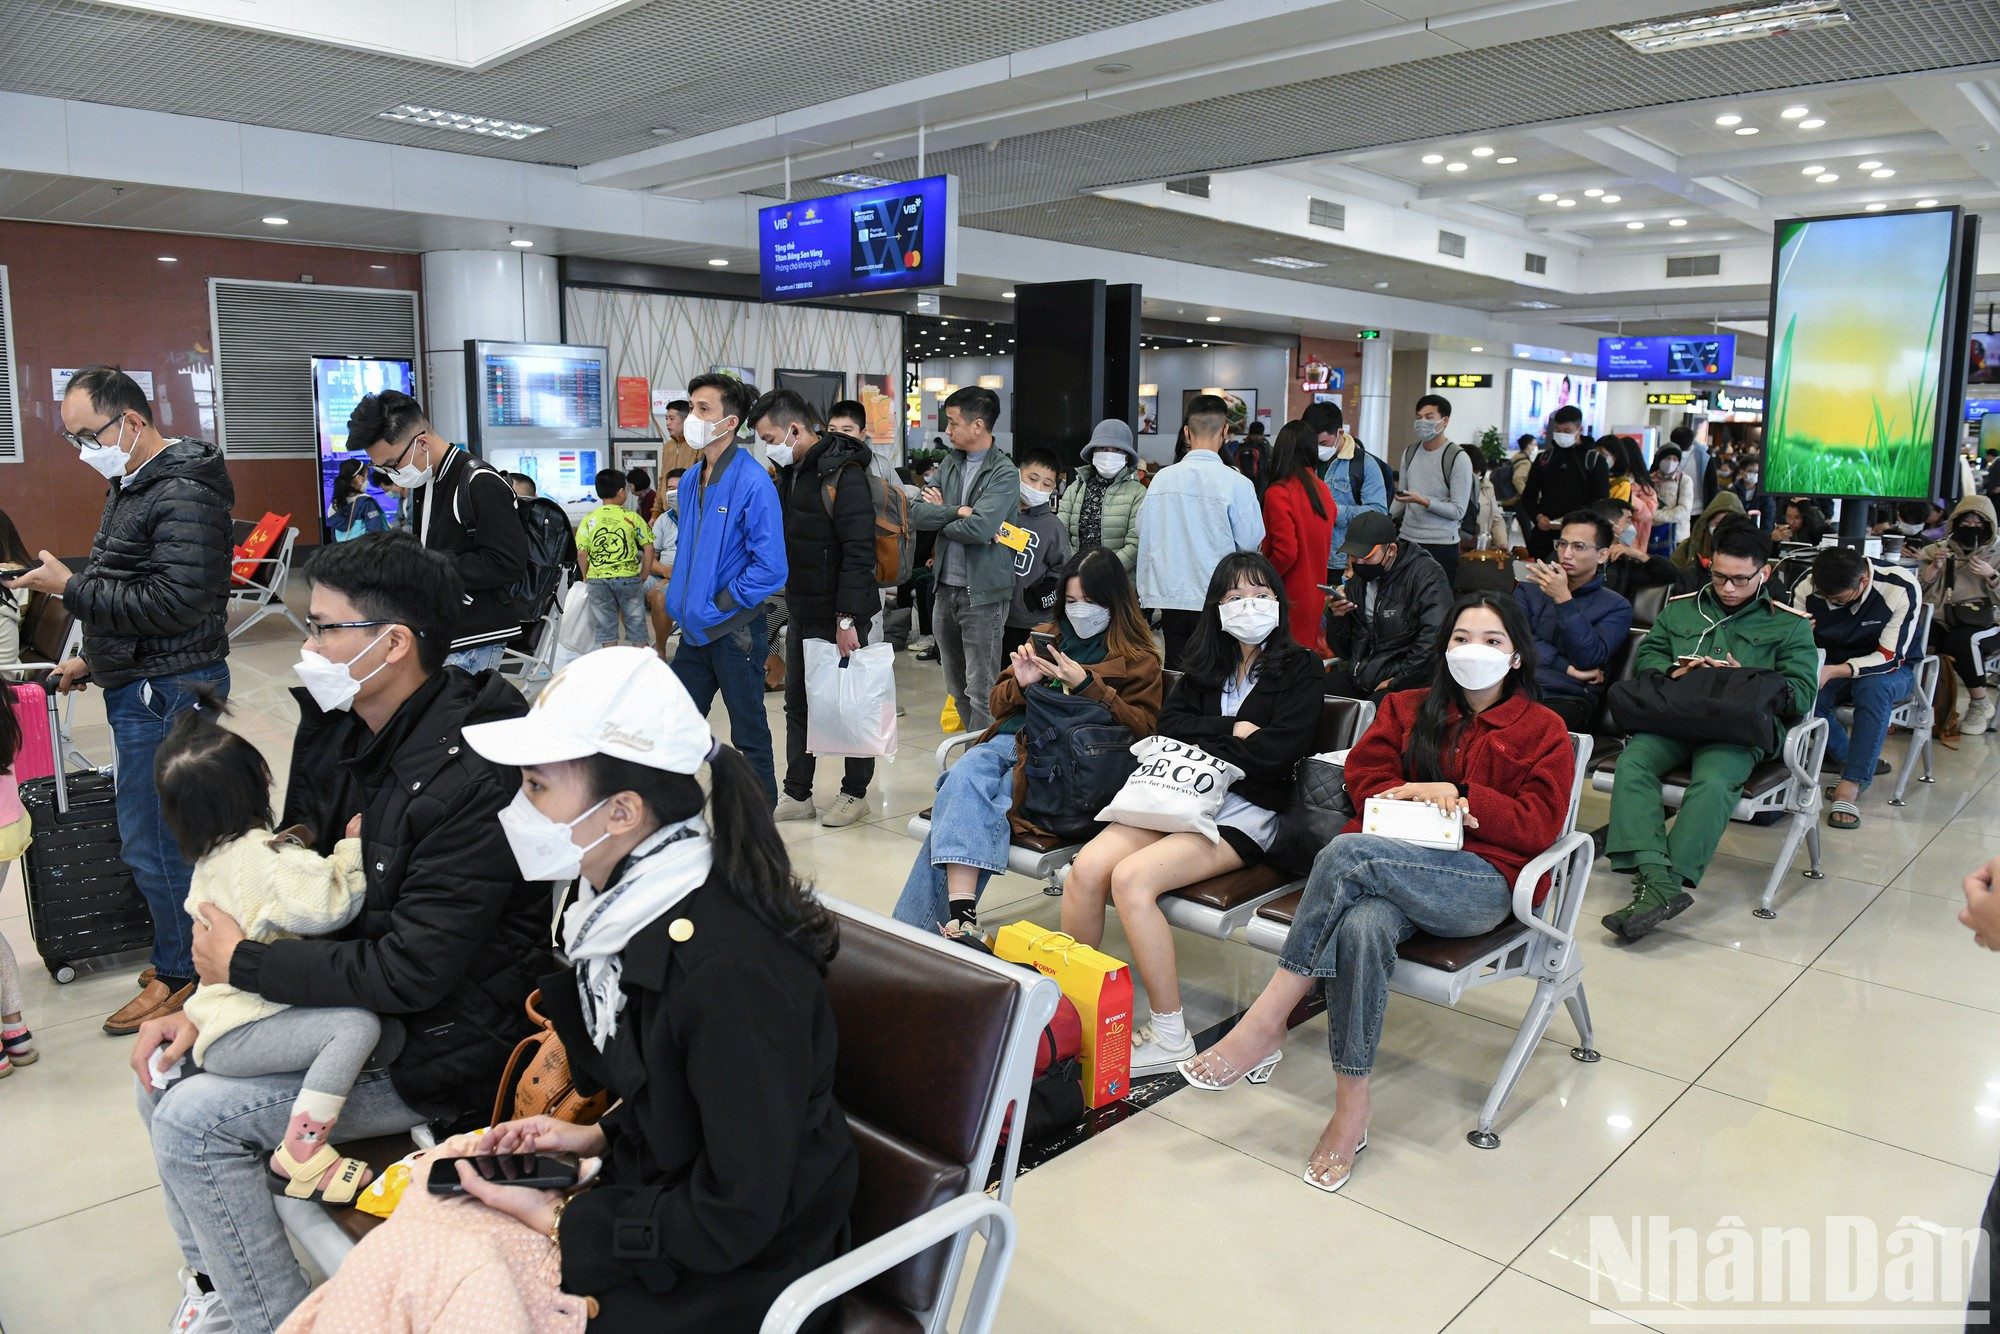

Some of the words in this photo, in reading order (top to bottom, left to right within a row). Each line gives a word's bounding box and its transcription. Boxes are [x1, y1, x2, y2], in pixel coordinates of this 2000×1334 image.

[903, 204, 917, 215] VIB
[774, 218, 788, 230] VIB
[775, 254, 787, 262] Titan
[800, 250, 810, 259] Sen
[1151, 735, 1227, 775] ODE
[1148, 779, 1159, 787] for
[1161, 782, 1180, 791] your
[1181, 788, 1199, 798] style
[1037, 963, 1056, 976] ORION
[1109, 1012, 1126, 1022] ORION
